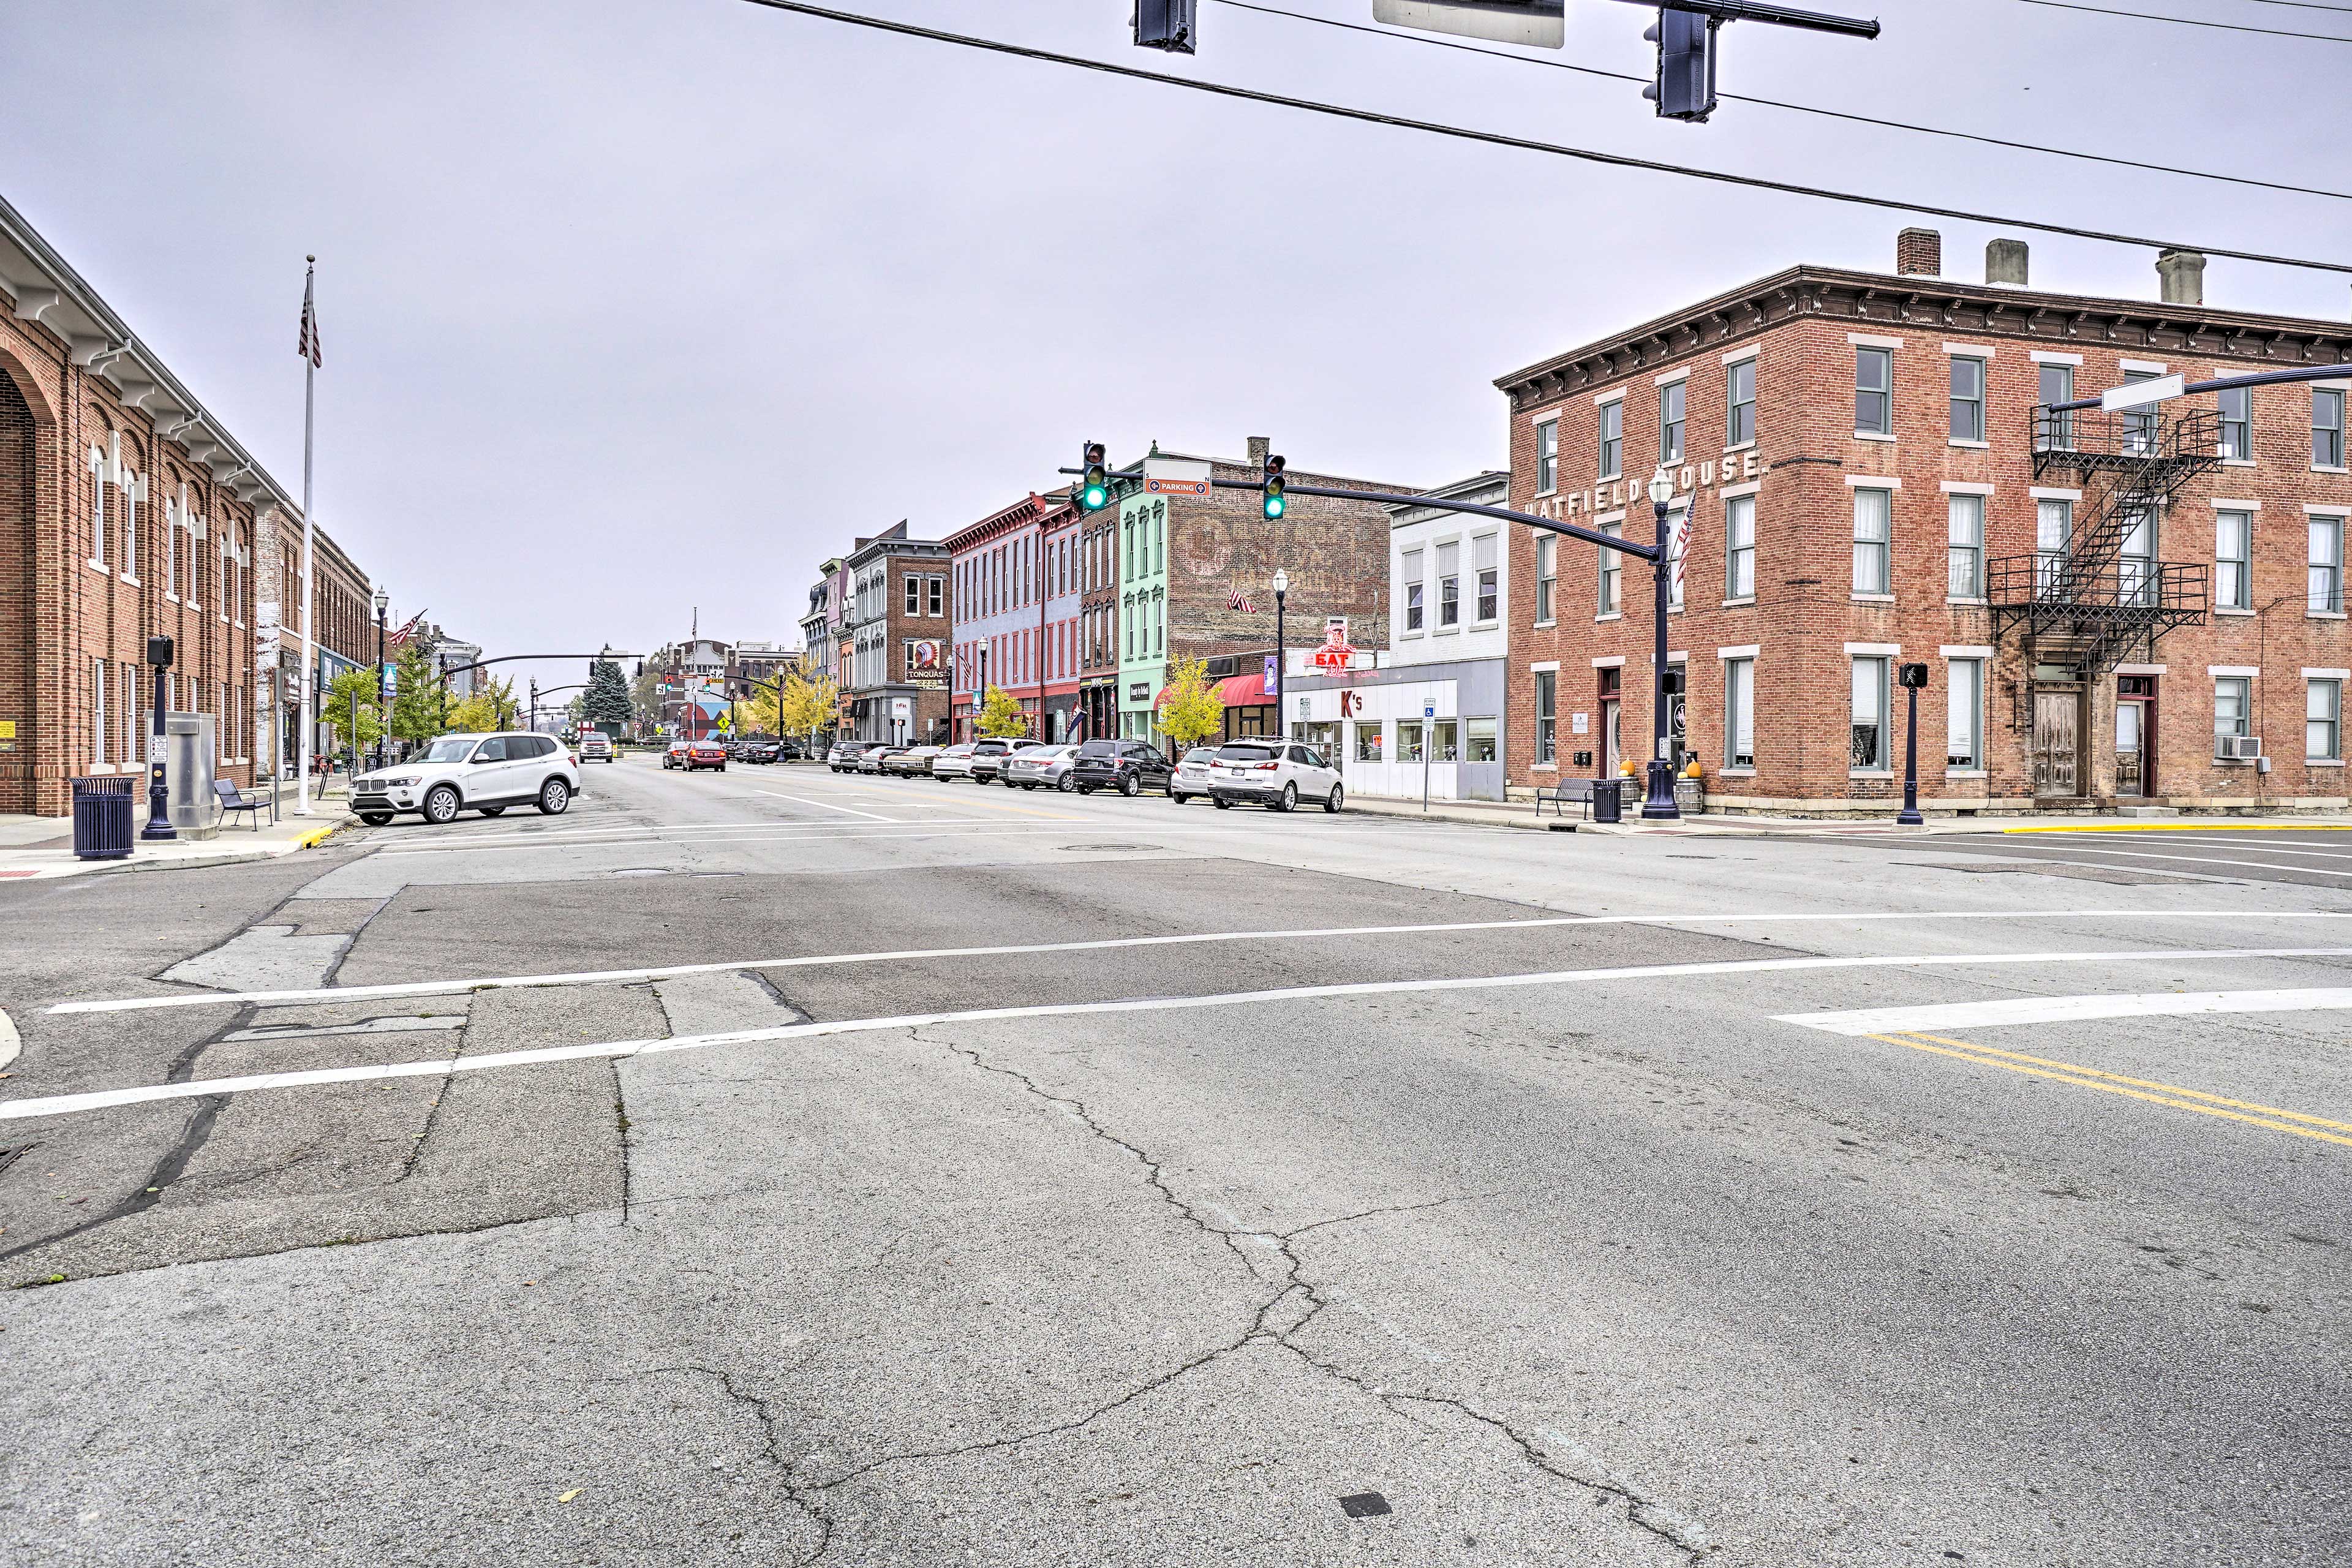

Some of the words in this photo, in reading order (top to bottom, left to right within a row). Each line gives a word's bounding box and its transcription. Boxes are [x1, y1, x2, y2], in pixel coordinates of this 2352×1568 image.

[1161, 483, 1194, 491] PARKING
[1525, 478, 1643, 519] HATFIELD
[1314, 654, 1349, 666] EAT
[1341, 690, 1363, 718] K's
